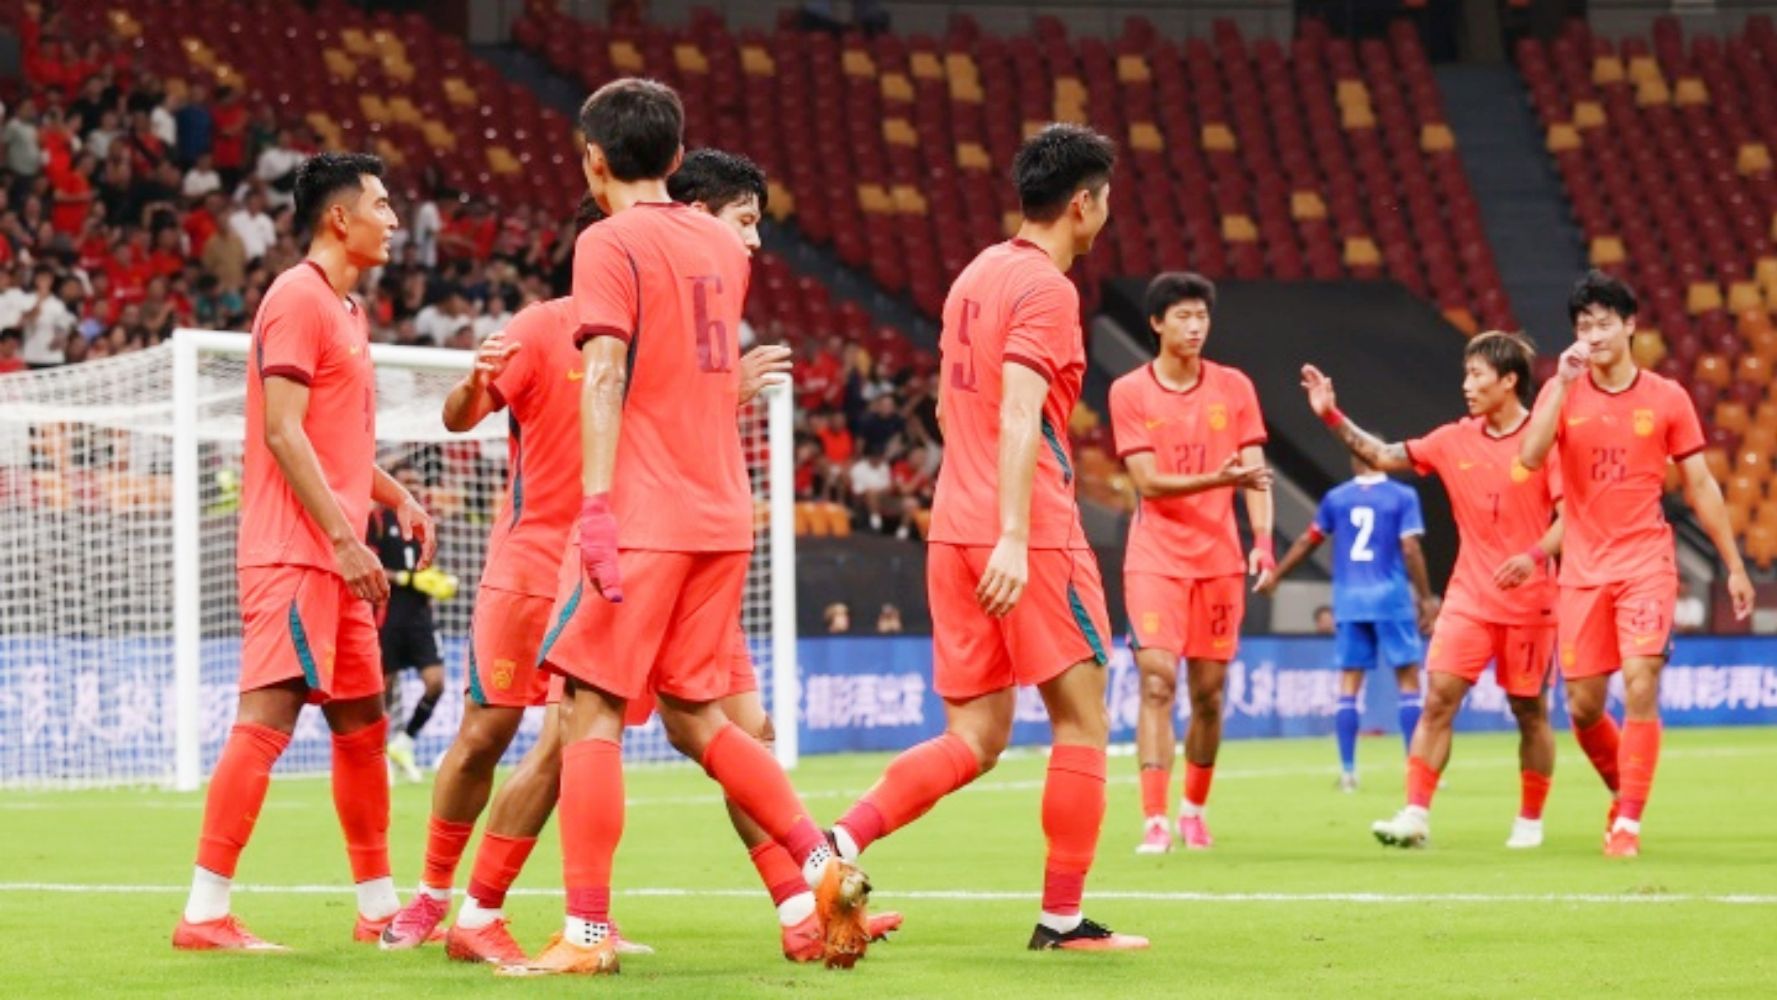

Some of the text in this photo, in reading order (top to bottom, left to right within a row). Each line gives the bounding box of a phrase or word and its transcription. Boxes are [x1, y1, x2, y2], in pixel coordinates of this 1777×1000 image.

[684, 276, 731, 373] 6
[950, 298, 979, 393] 5
[1174, 443, 1206, 475] 27
[1591, 448, 1627, 482] 25
[1486, 493, 1500, 524] 7
[1350, 506, 1375, 562] 2
[1211, 604, 1238, 635] 2
[1520, 640, 1535, 674] 7
